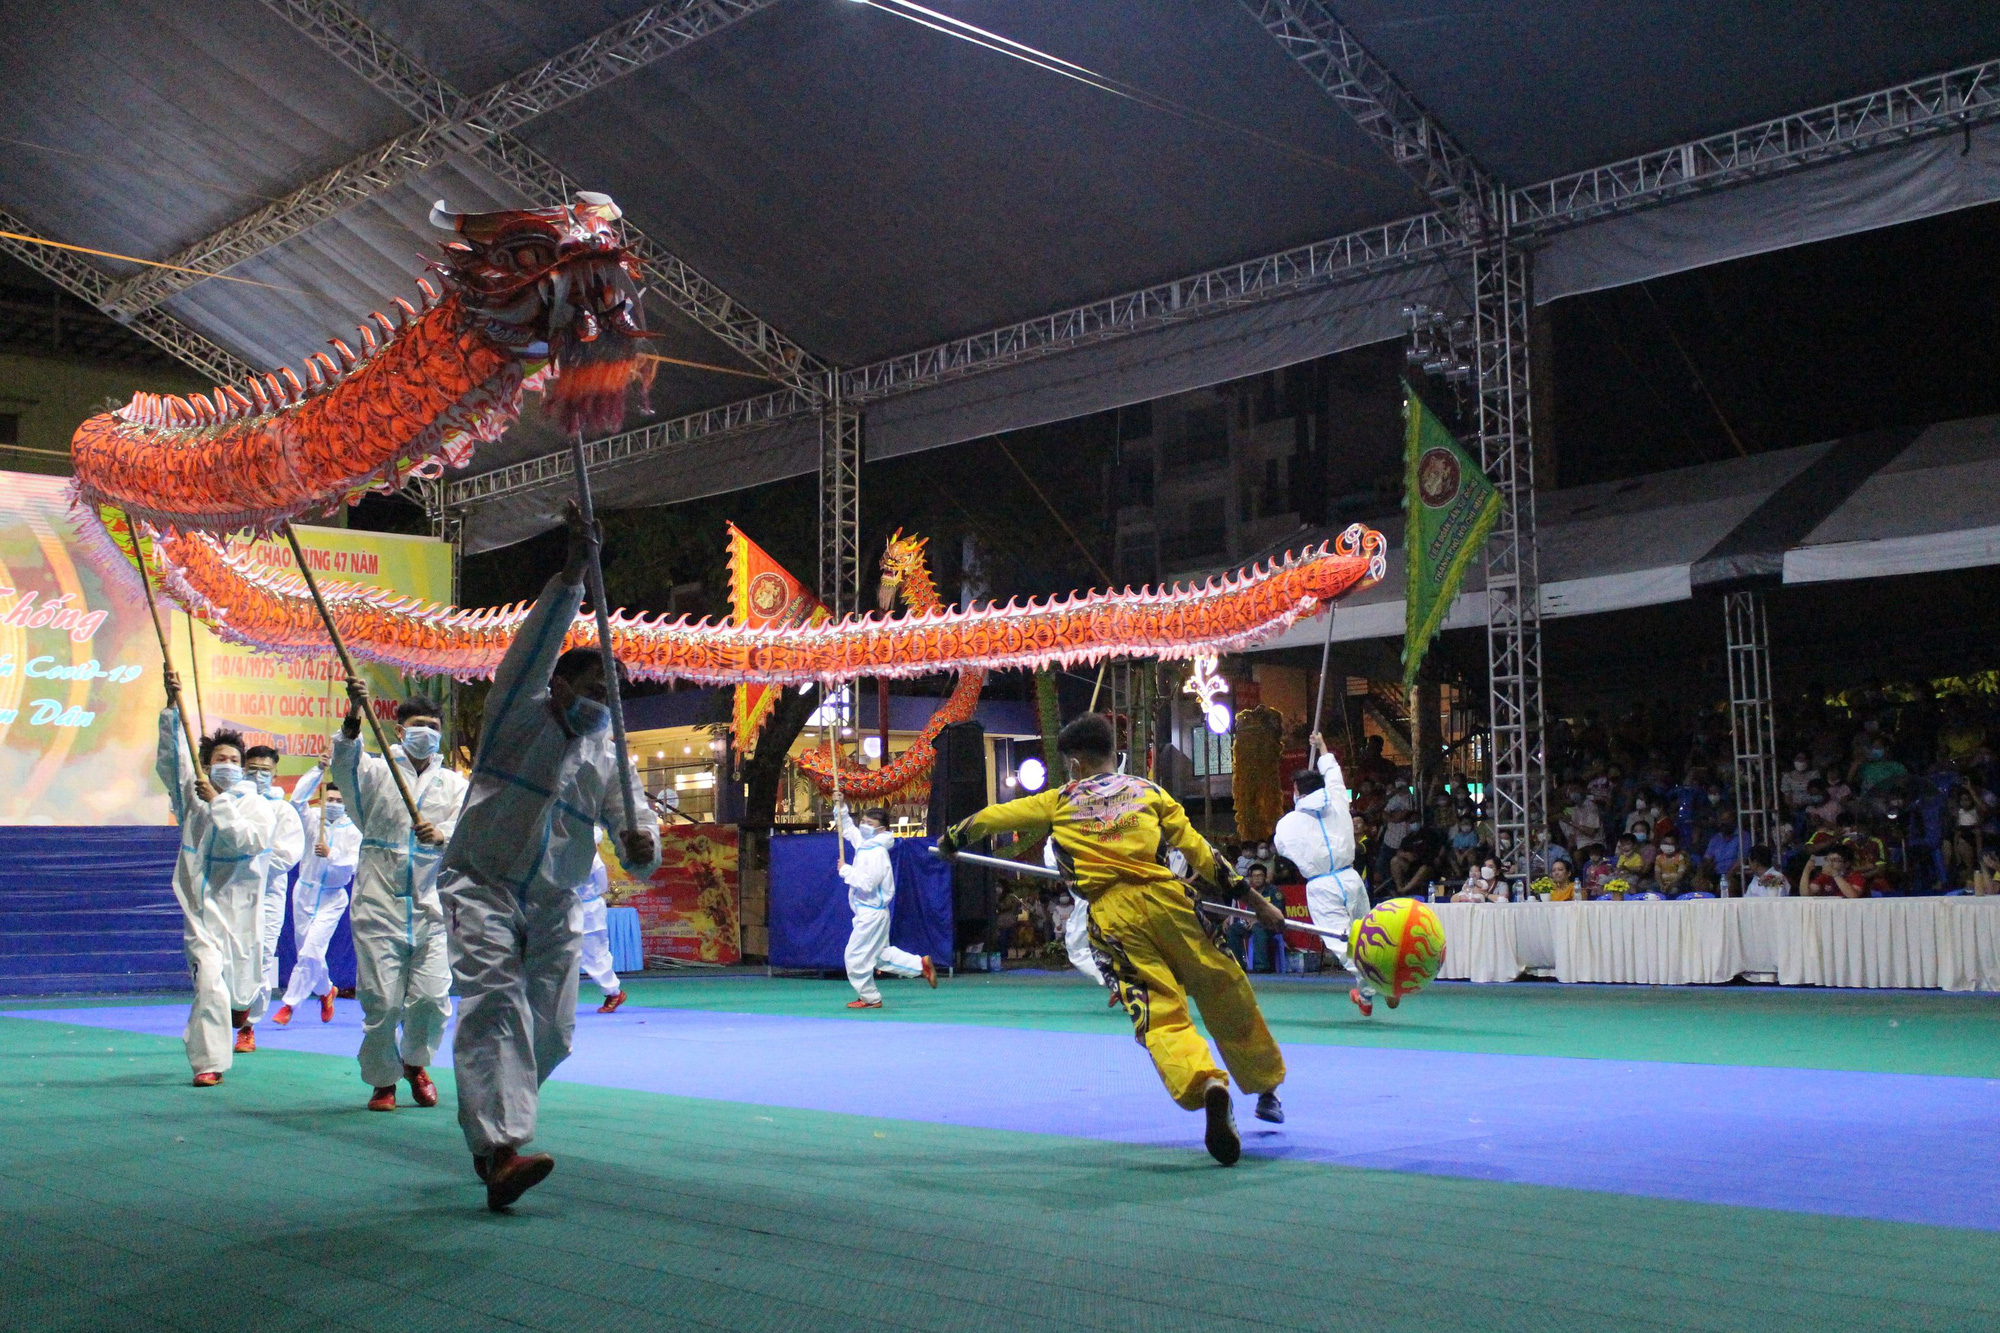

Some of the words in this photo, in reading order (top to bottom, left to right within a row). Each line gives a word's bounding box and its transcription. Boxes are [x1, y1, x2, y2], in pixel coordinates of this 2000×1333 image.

[256, 544, 292, 569] CHÀO
[333, 551, 348, 573] 47
[24, 655, 142, 683] Covid-19
[286, 658, 347, 681] 30/4/222
[30, 698, 95, 727] Dân
[239, 690, 275, 716] NGÀY
[279, 689, 314, 717] QUỐC
